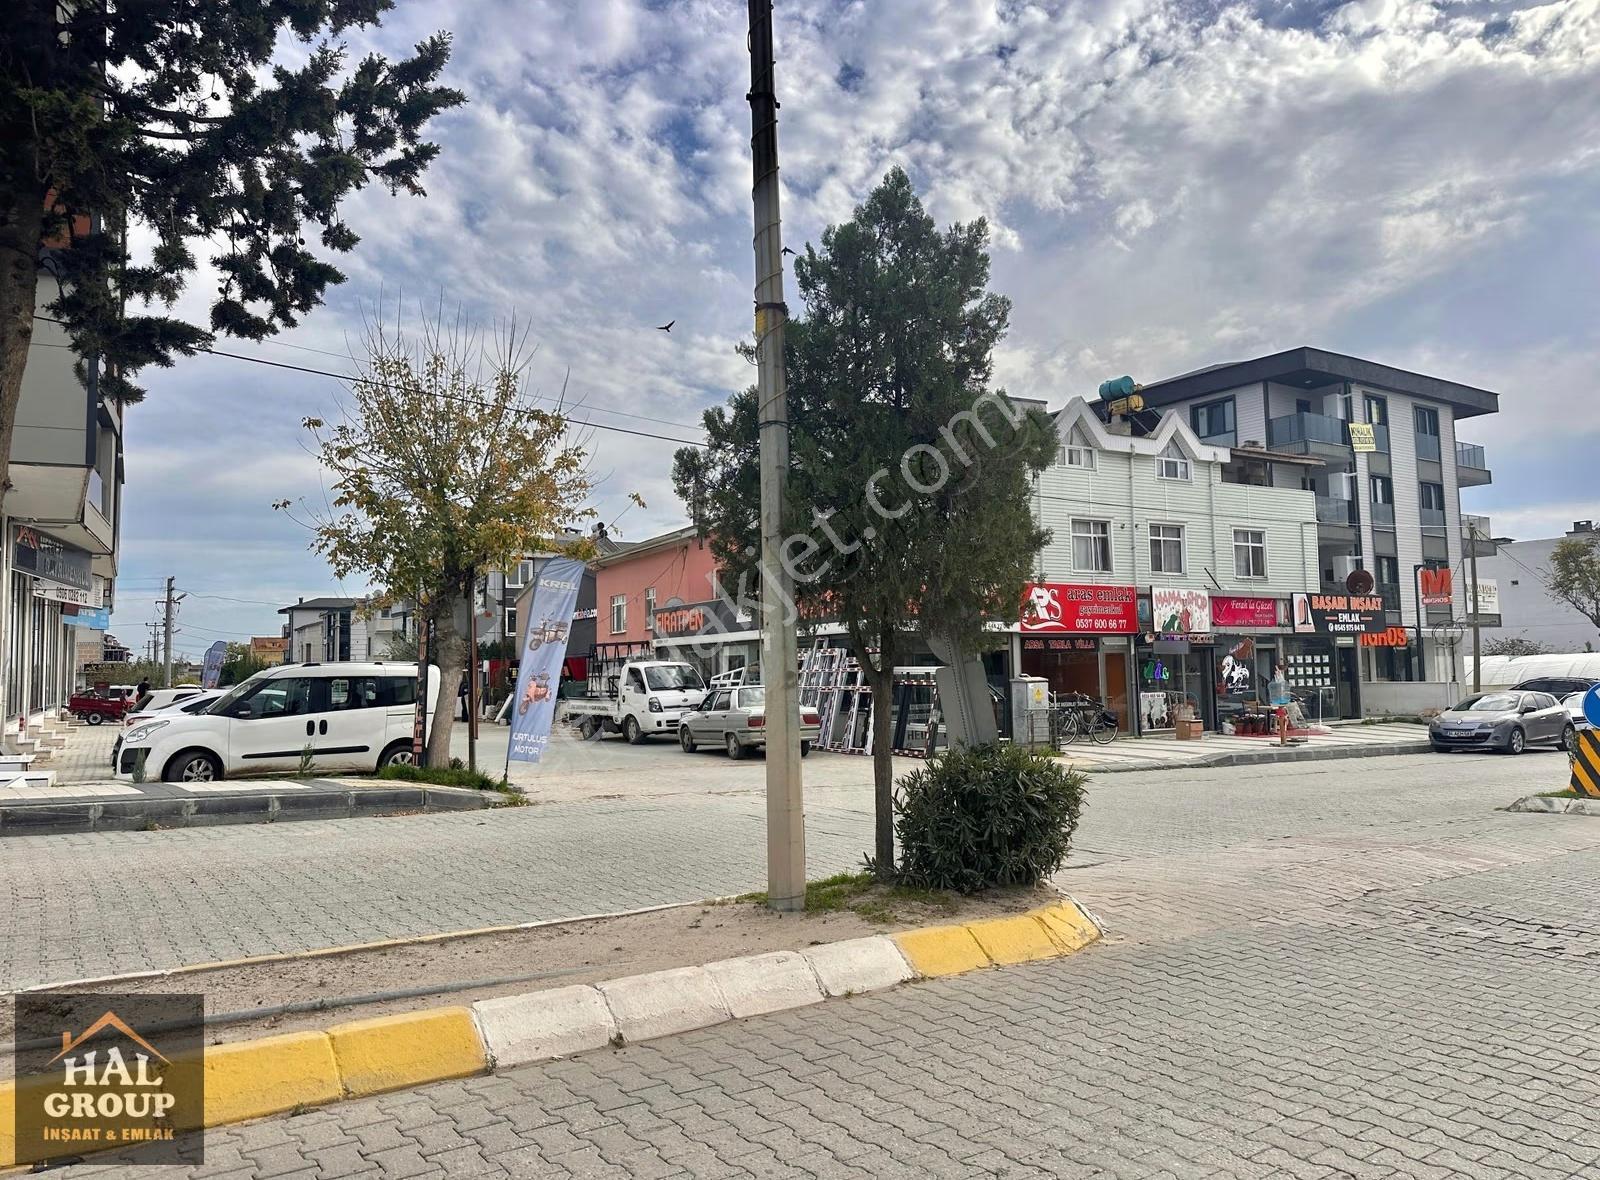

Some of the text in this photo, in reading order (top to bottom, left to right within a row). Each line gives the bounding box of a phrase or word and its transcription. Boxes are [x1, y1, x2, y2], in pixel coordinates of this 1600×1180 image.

[539, 578, 577, 591] KRAL
[1067, 587, 1133, 602] aras emlak
[1155, 590, 1181, 608] MAMA
[1311, 595, 1382, 612] BAŞARI İNŞAAT
[656, 608, 704, 633] FIRATPEN
[1075, 619, 1093, 629] 0537
[1094, 619, 1107, 629] 600
[1118, 619, 1127, 629] 77
[1338, 613, 1361, 623] EMLAK
[1360, 627, 1407, 646] IGROS
[1024, 640, 1044, 649] ARSA
[514, 745, 540, 754] MOTOR
